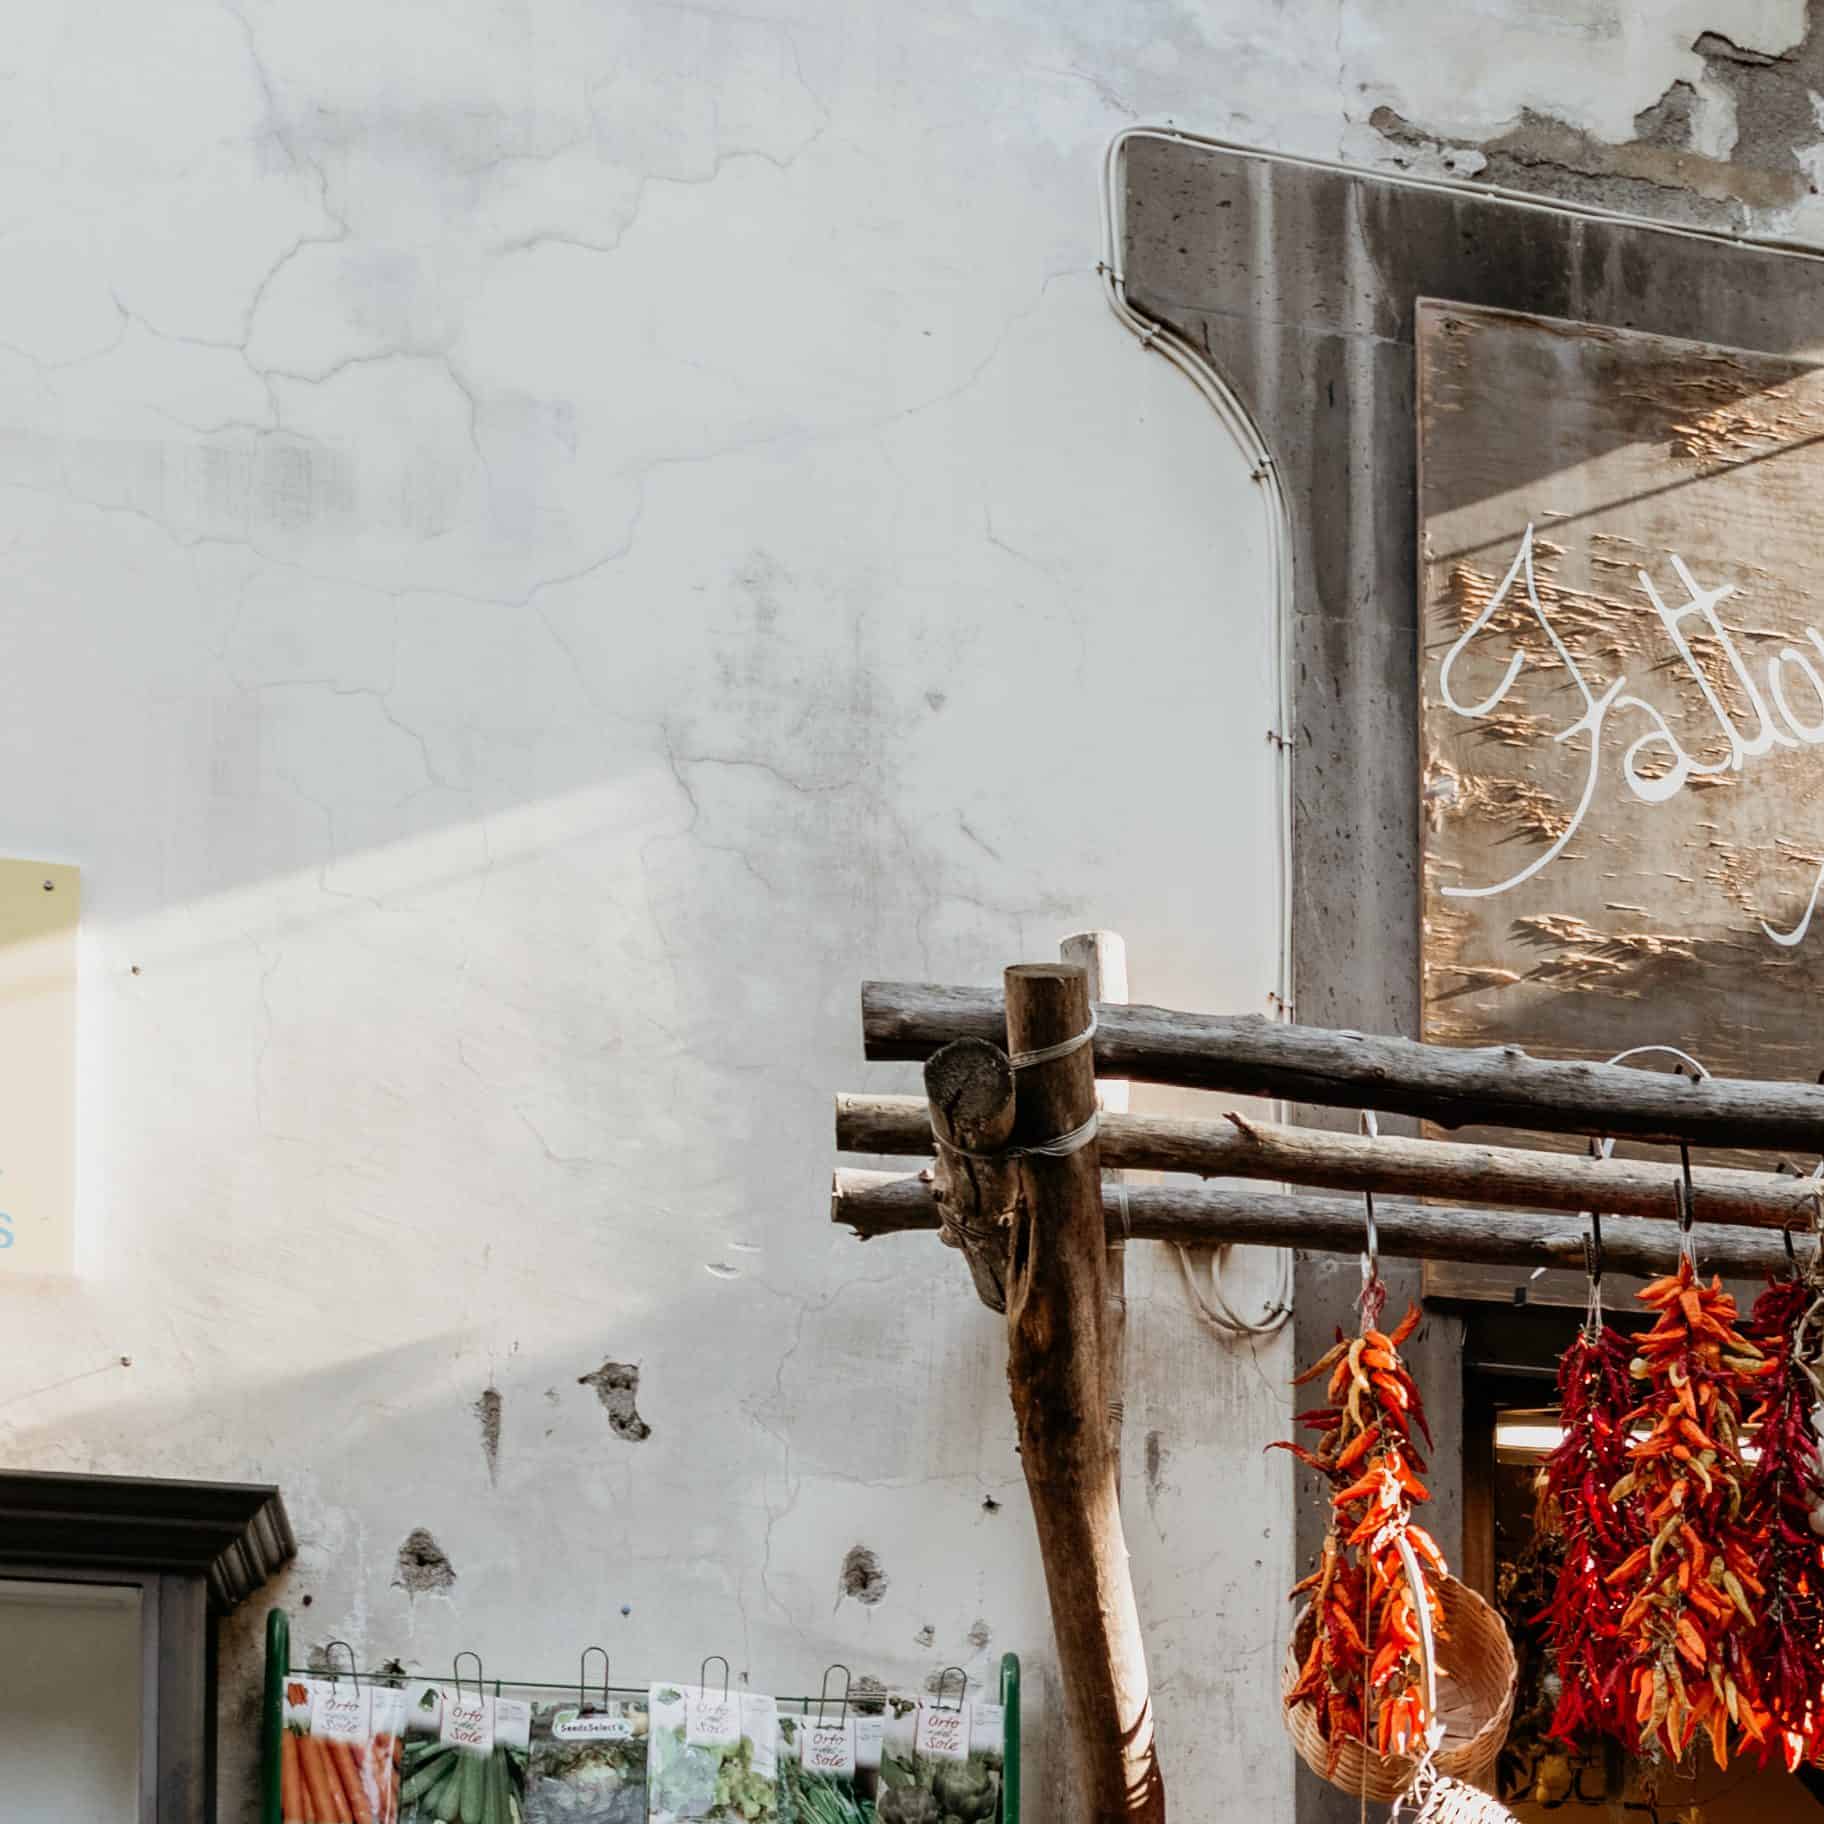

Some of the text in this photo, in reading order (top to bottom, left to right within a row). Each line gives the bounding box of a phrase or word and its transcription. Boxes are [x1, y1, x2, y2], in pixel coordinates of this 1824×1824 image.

[452, 1706, 482, 1720] Orto
[928, 1716, 960, 1729] Orto
[449, 1730, 482, 1744] Sole
[813, 1733, 844, 1745] Orto
[925, 1738, 959, 1752] Sole
[811, 1755, 847, 1768] Sole
